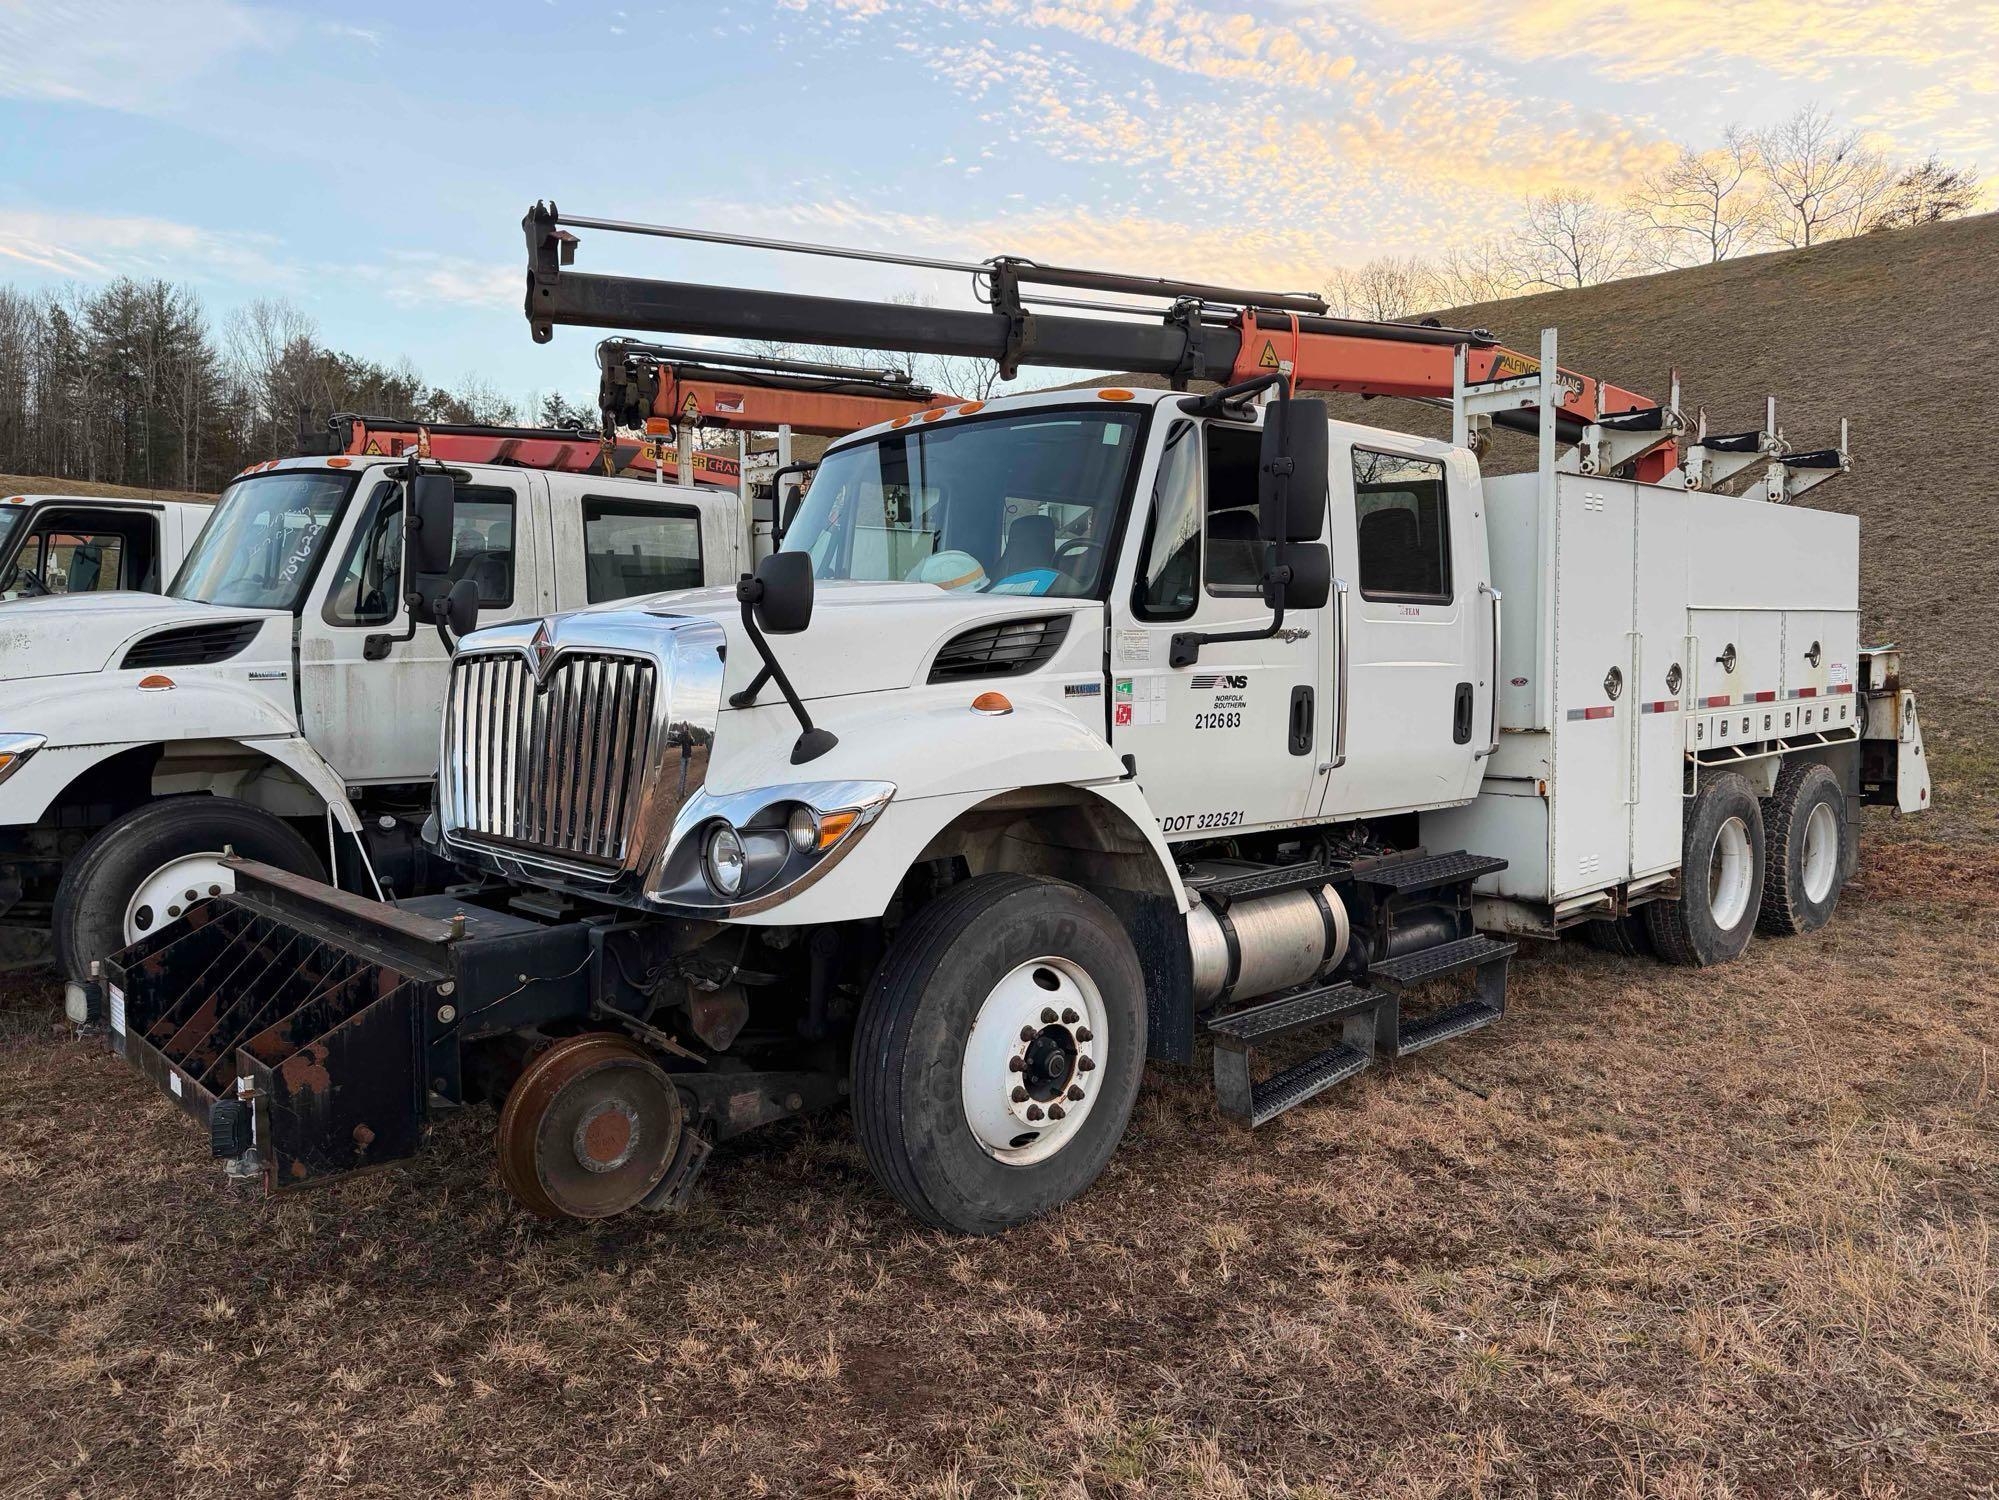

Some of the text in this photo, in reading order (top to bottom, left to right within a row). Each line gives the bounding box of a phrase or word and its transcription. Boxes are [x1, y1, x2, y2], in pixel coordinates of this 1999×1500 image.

[1556, 373, 1581, 392] RANE
[708, 460, 739, 475] CRAN
[279, 524, 321, 581] 709622
[1213, 701, 1247, 709] SOUTHERN
[1215, 694, 1244, 702] NORFOLK
[1195, 712, 1241, 729] 212683
[1163, 810, 1244, 832] DOT 322521
